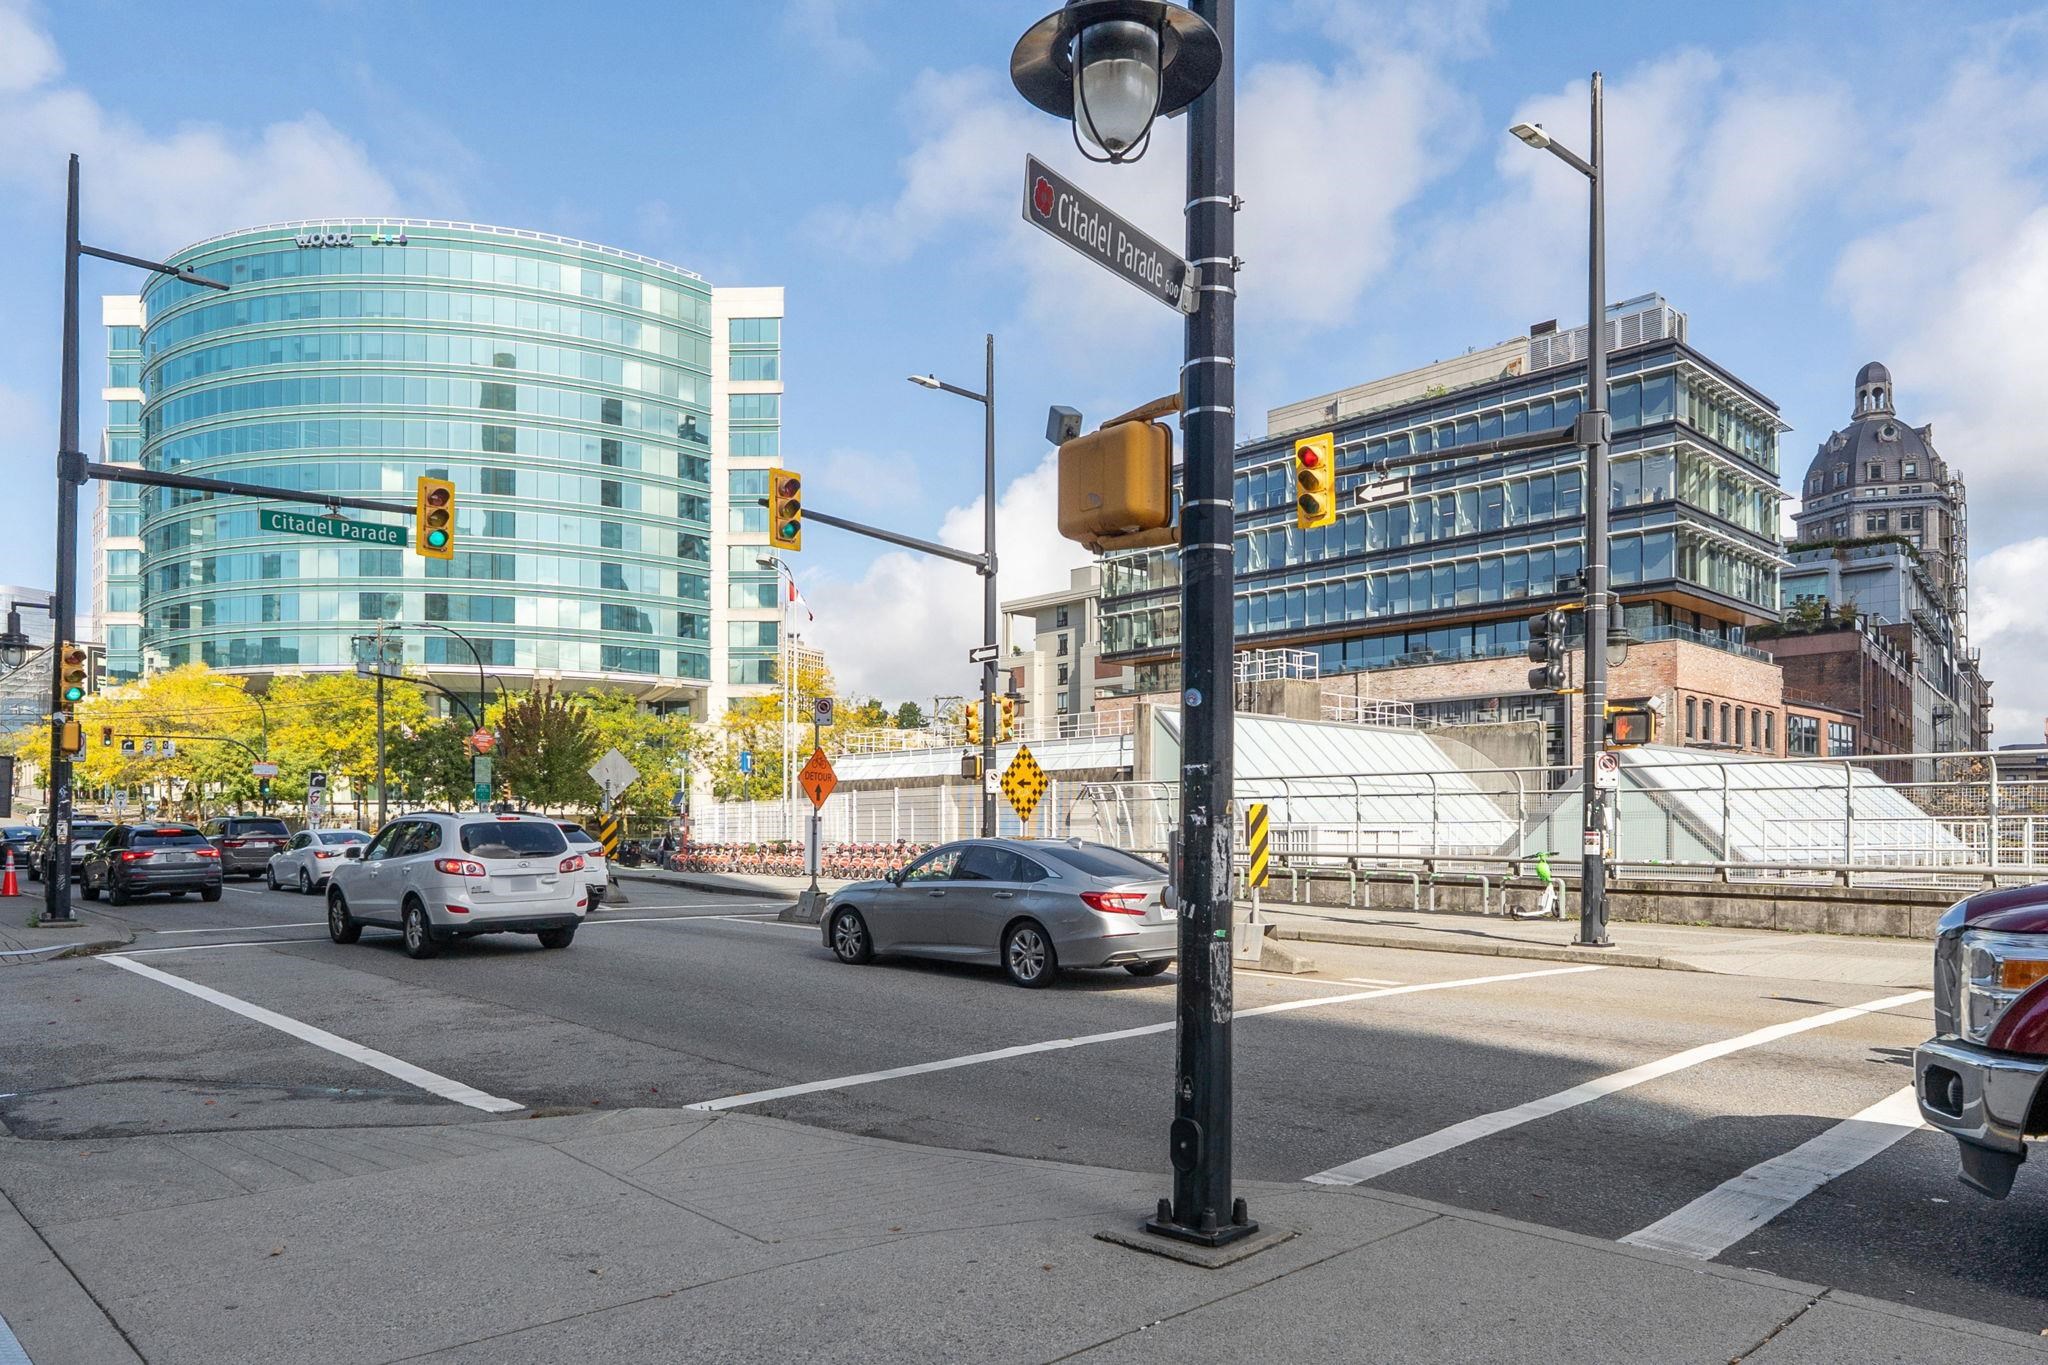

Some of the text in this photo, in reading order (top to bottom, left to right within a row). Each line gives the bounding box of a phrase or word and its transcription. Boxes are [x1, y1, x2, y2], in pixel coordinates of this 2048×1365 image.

[1057, 192, 1180, 299] Citadel Parade 600
[271, 513, 398, 543] Citadel Parade
[804, 771, 833, 782] DETOUR
